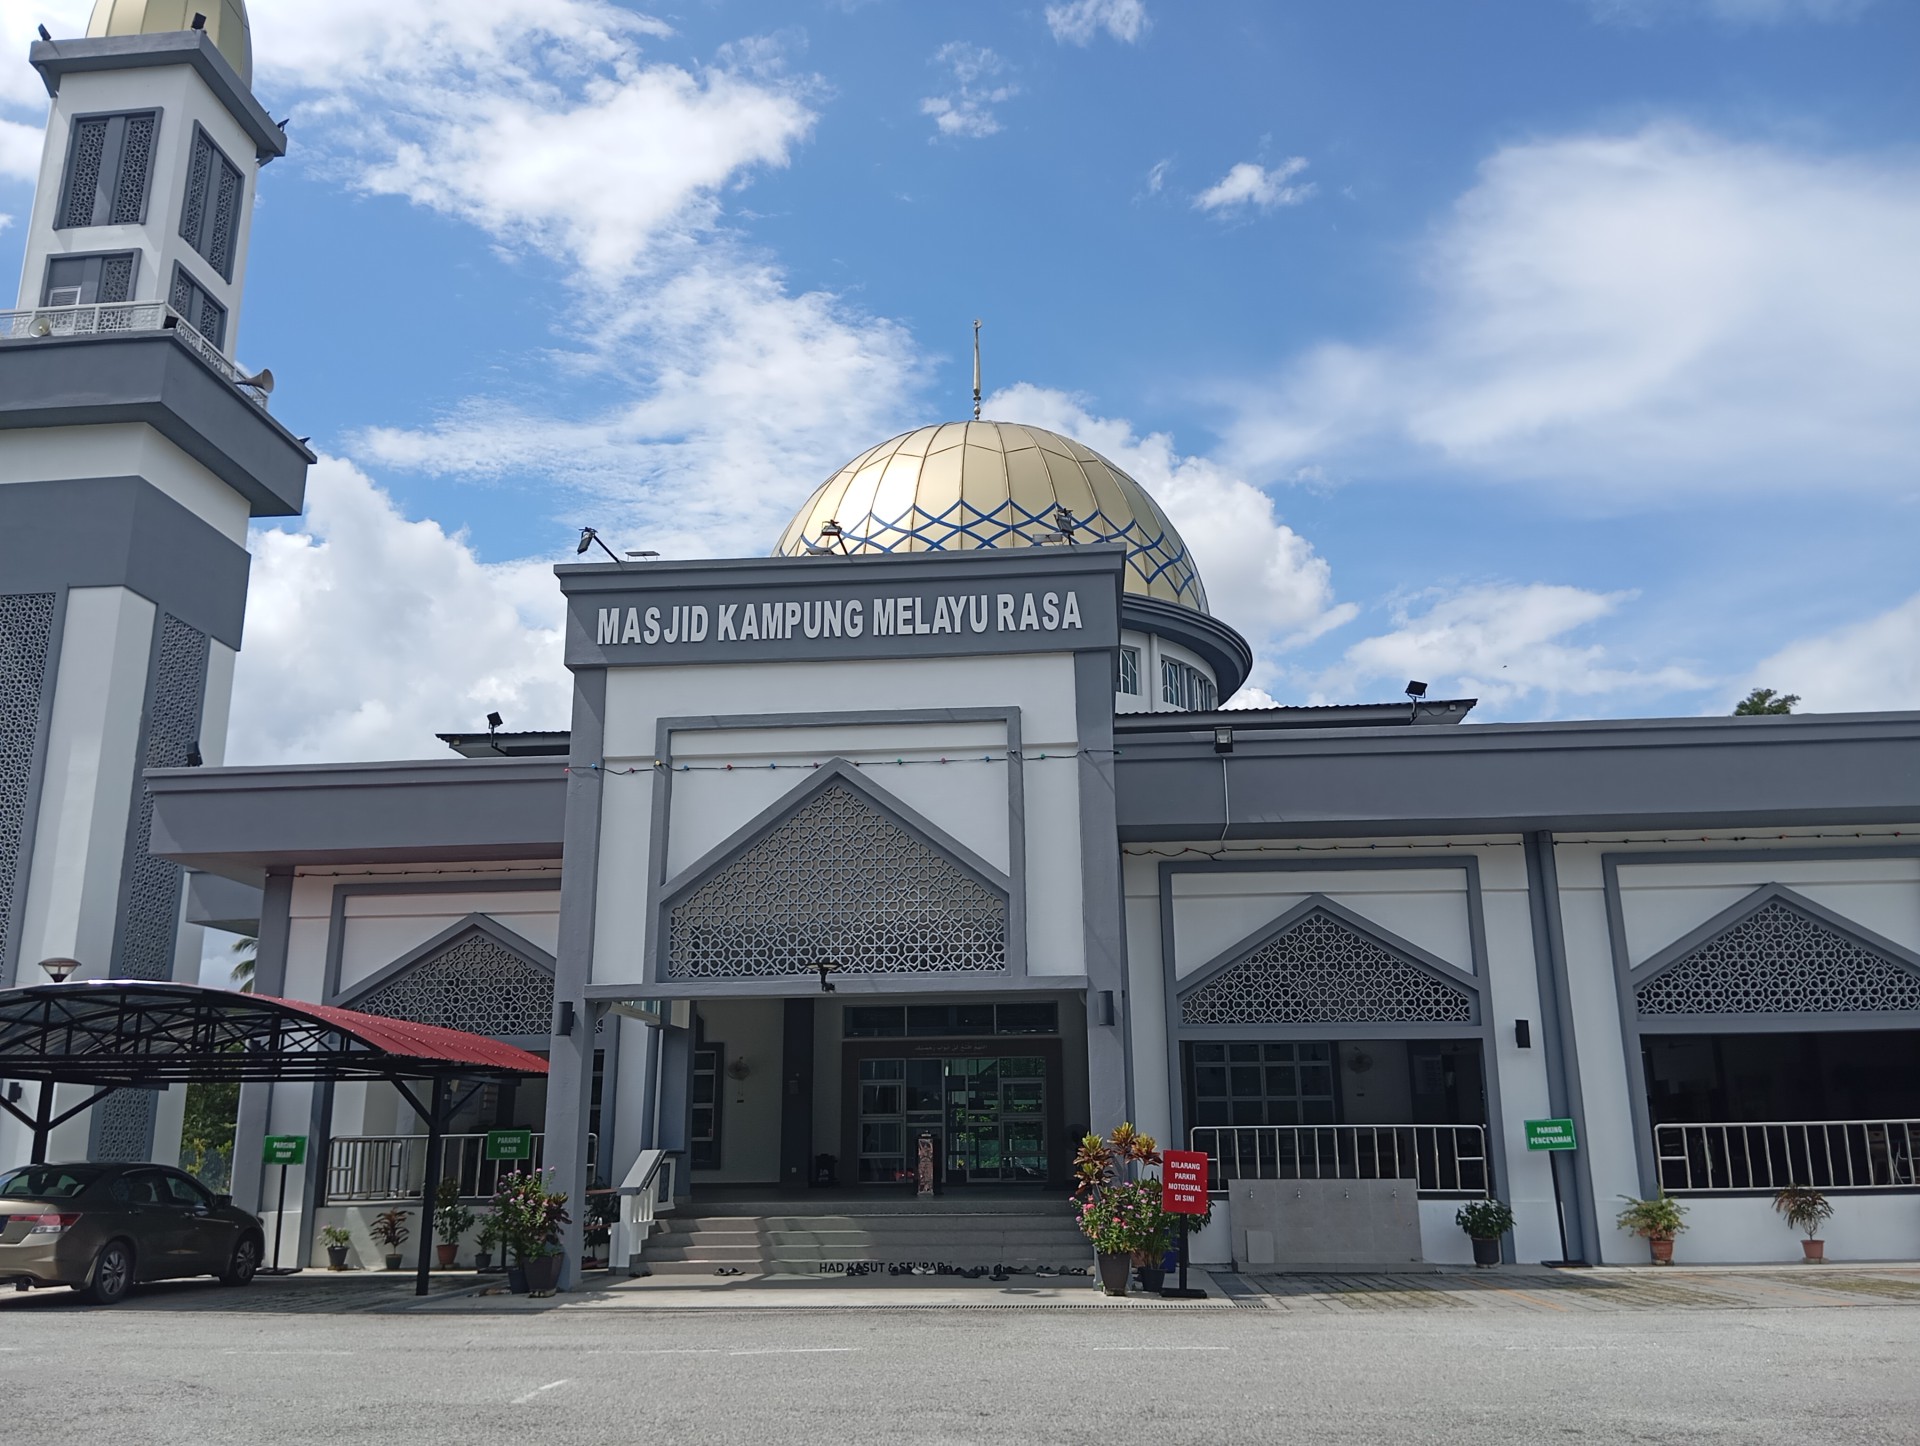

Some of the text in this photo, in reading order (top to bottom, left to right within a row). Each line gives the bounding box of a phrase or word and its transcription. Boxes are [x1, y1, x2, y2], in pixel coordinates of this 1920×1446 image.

[596, 590, 1083, 646] MASJID KAMPUNG MELAYU RASA
[1536, 1126, 1563, 1134] PARKING
[497, 1136, 521, 1144] PARKING
[1170, 1161, 1201, 1170] DILARANG
[1174, 1172, 1197, 1181] PARKIR
[1168, 1182, 1202, 1193] MOTOSIKAL
[1174, 1194, 1195, 1203] DI SINI
[819, 1262, 844, 1273] HAD
[847, 1262, 886, 1273] KASUT
